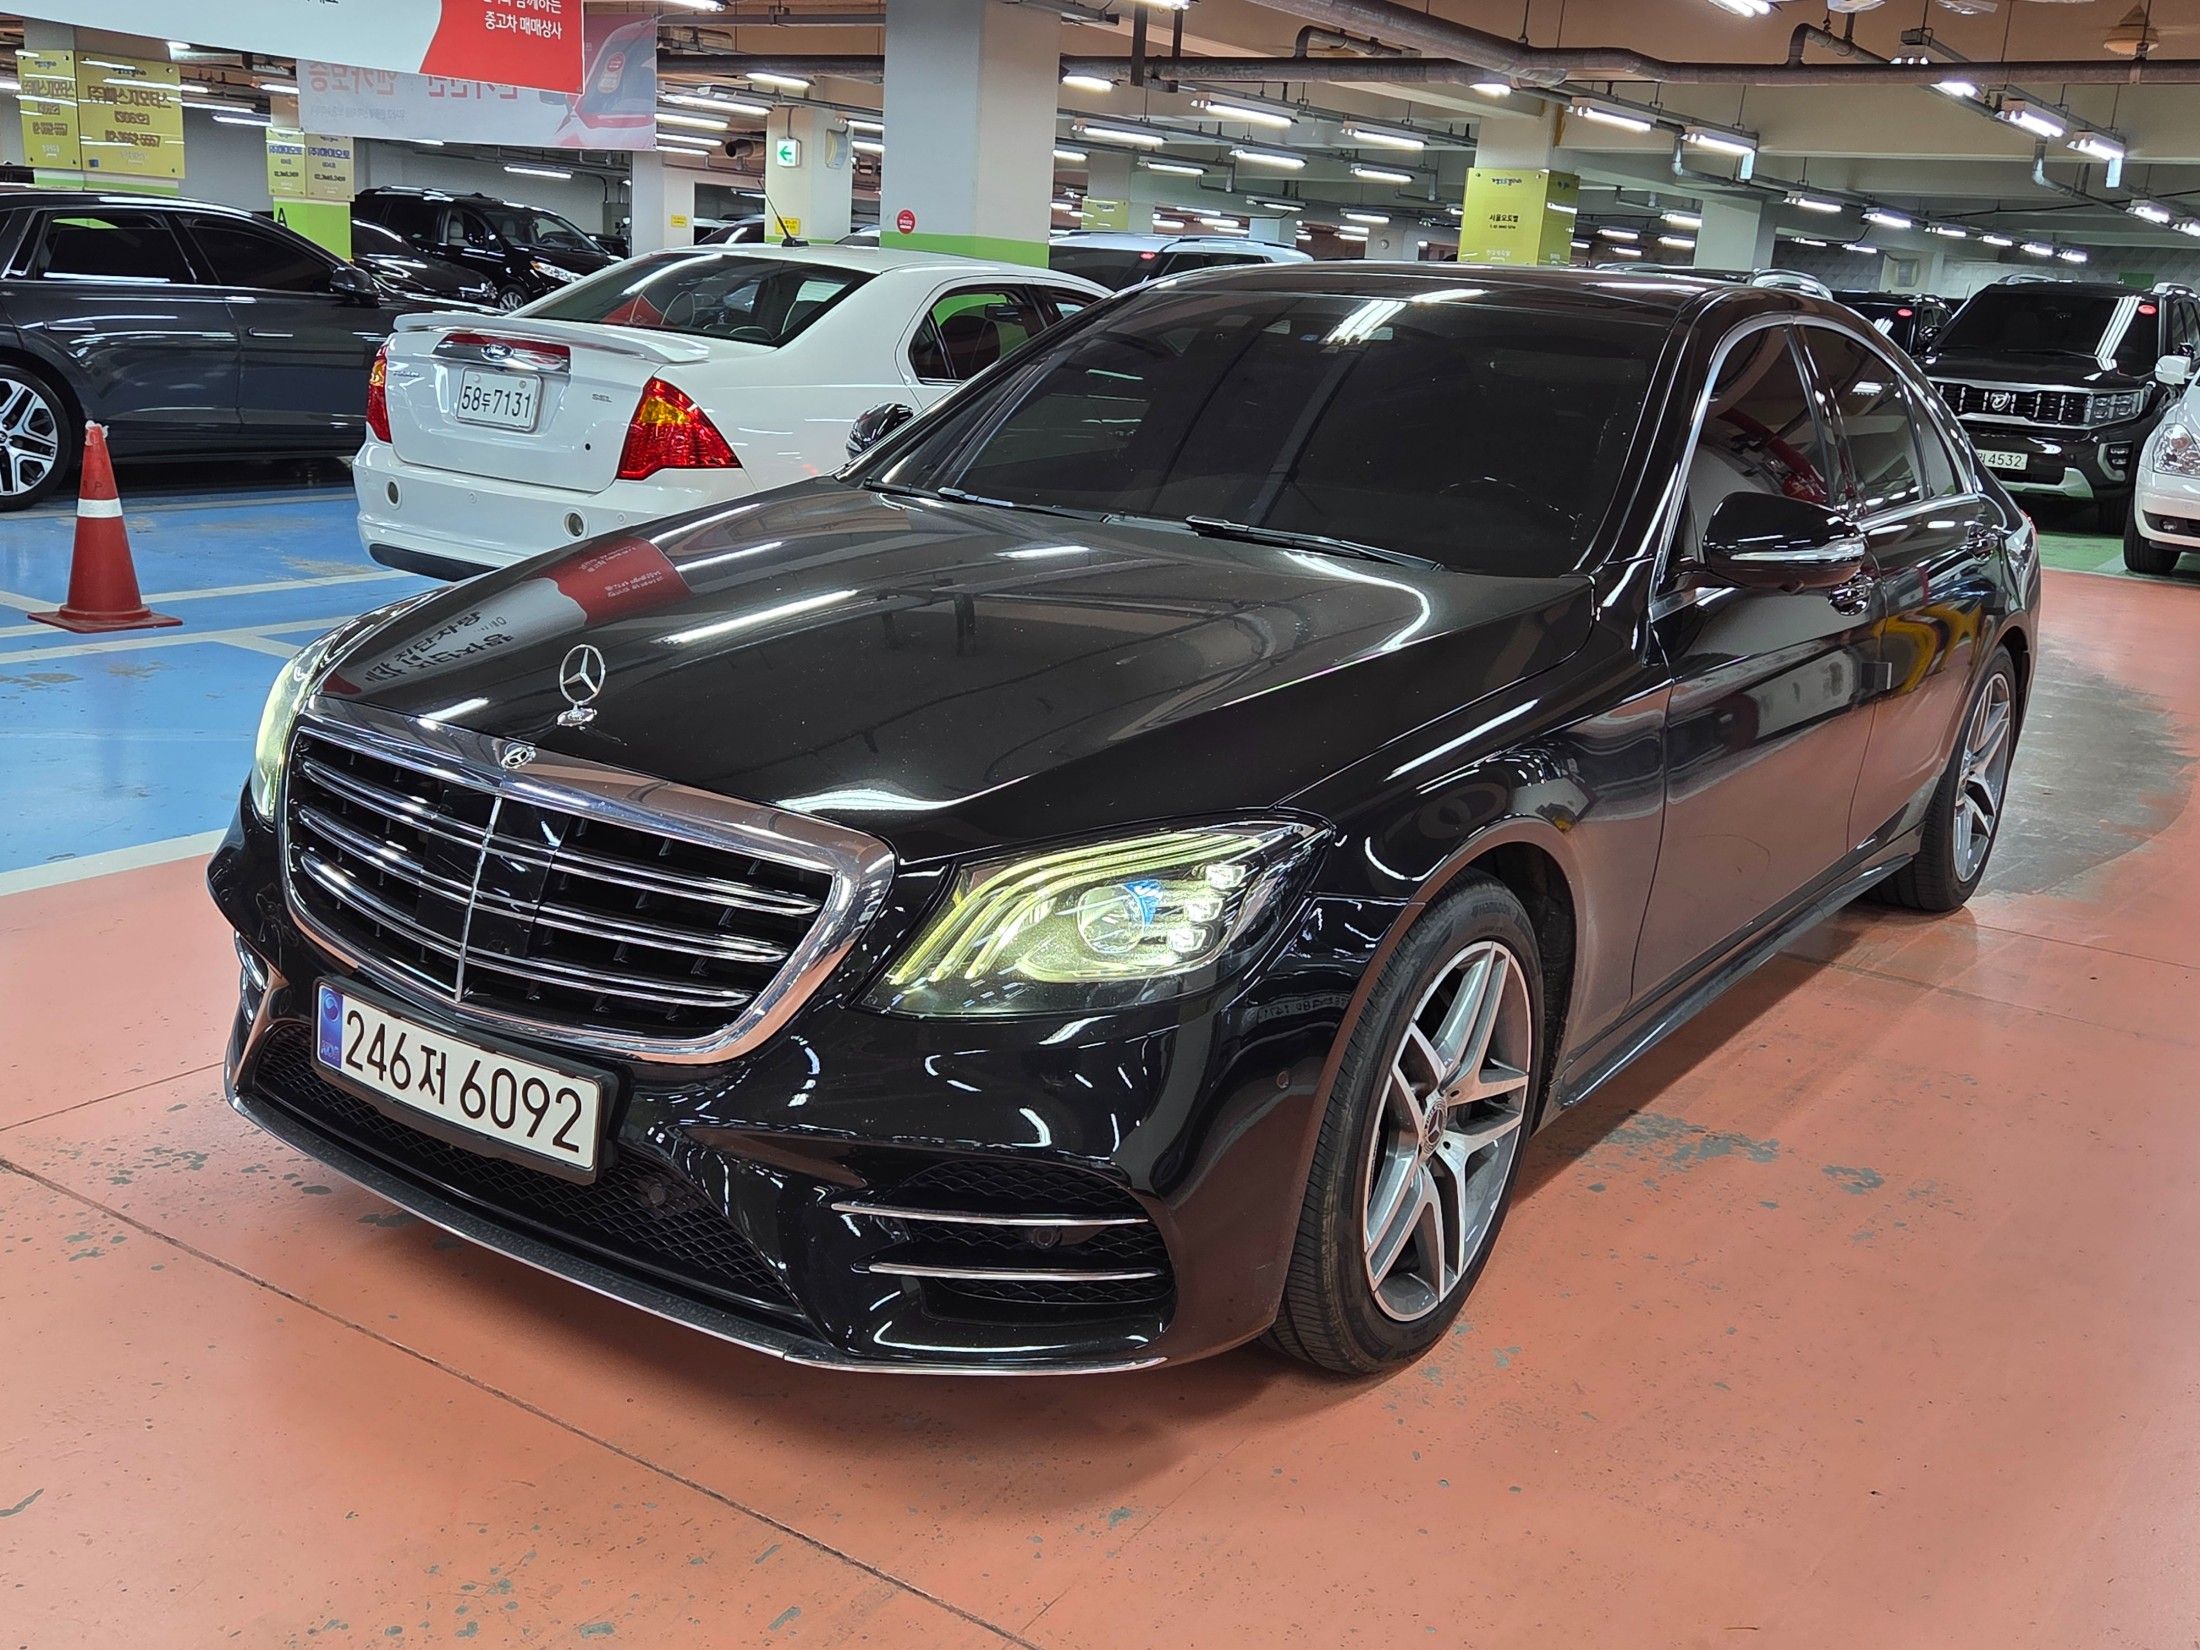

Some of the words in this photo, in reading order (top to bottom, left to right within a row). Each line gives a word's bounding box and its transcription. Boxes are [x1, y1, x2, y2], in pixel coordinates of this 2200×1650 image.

[485, 11, 518, 33] 중고차
[519, 17, 562, 39] 매매상사
[461, 386, 532, 418] 58두7131
[1989, 454, 2022, 467] 4532
[346, 1010, 447, 1105] 246저
[459, 1060, 582, 1154] 6092
